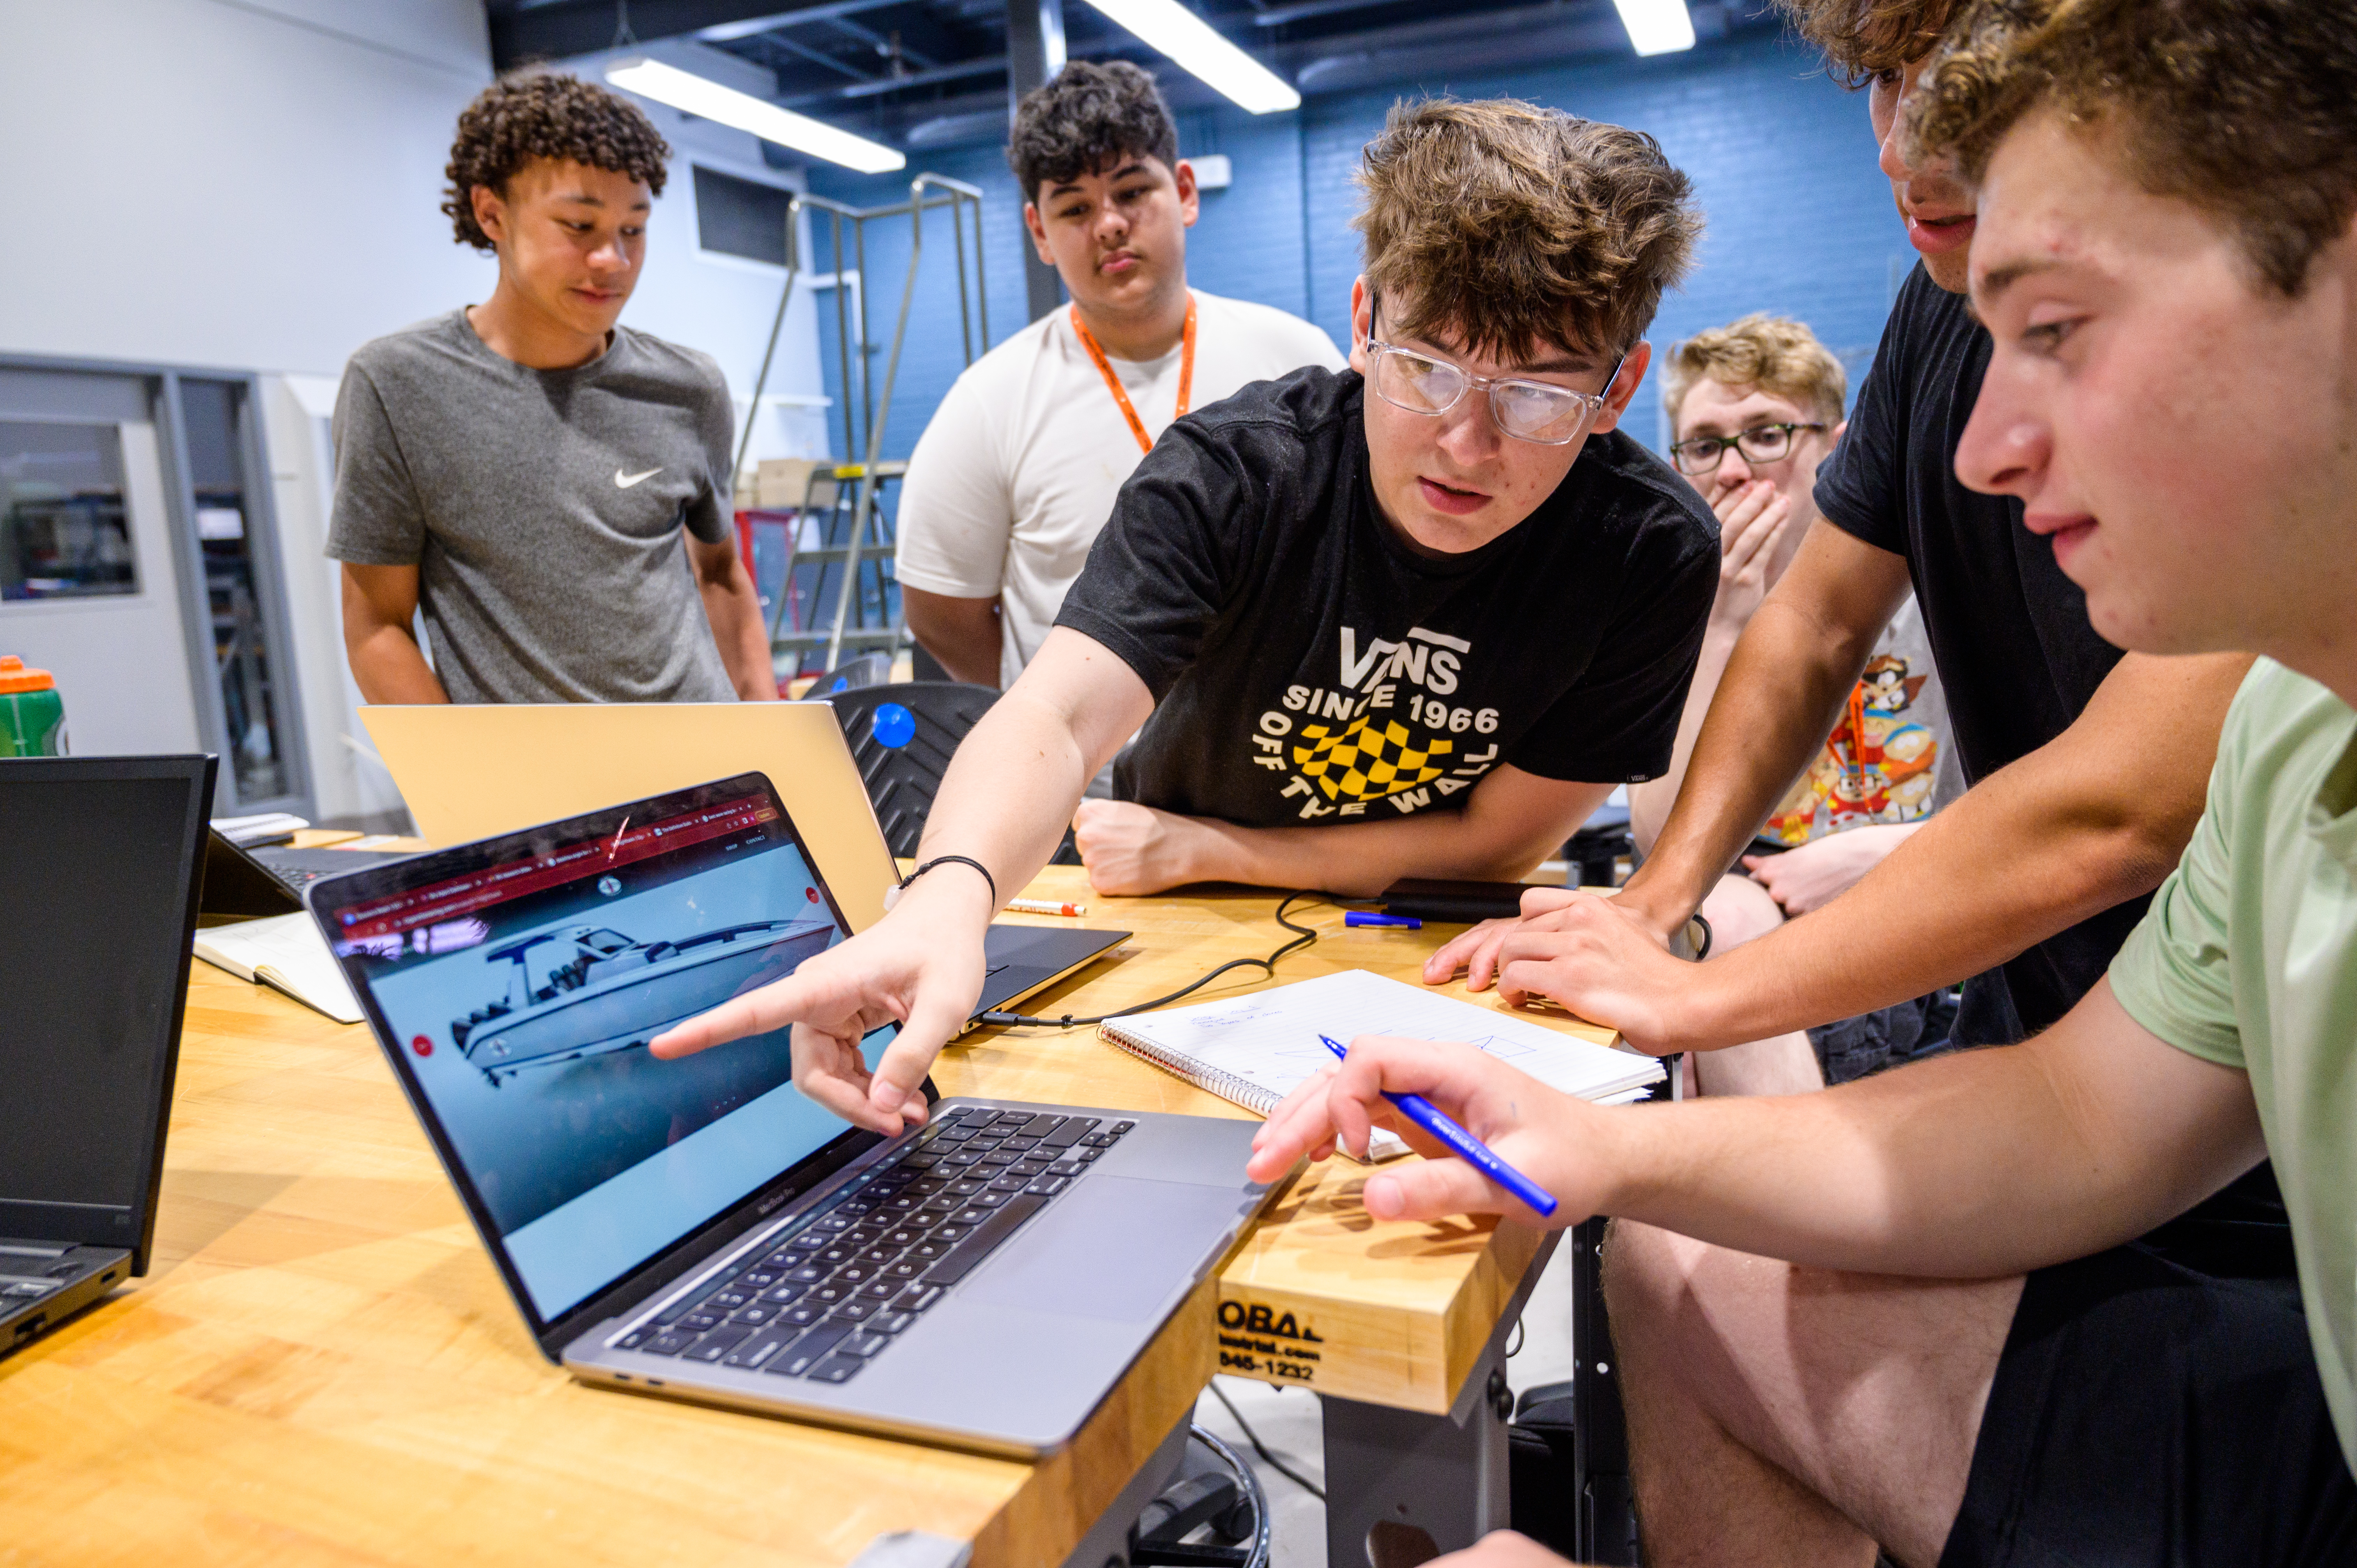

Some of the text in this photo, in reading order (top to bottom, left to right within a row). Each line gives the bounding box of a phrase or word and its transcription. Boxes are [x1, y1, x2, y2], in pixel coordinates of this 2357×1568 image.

[1410, 694, 1499, 734] 1966
[1252, 711, 1287, 771] OFF
[1387, 743, 1498, 814] WALL
